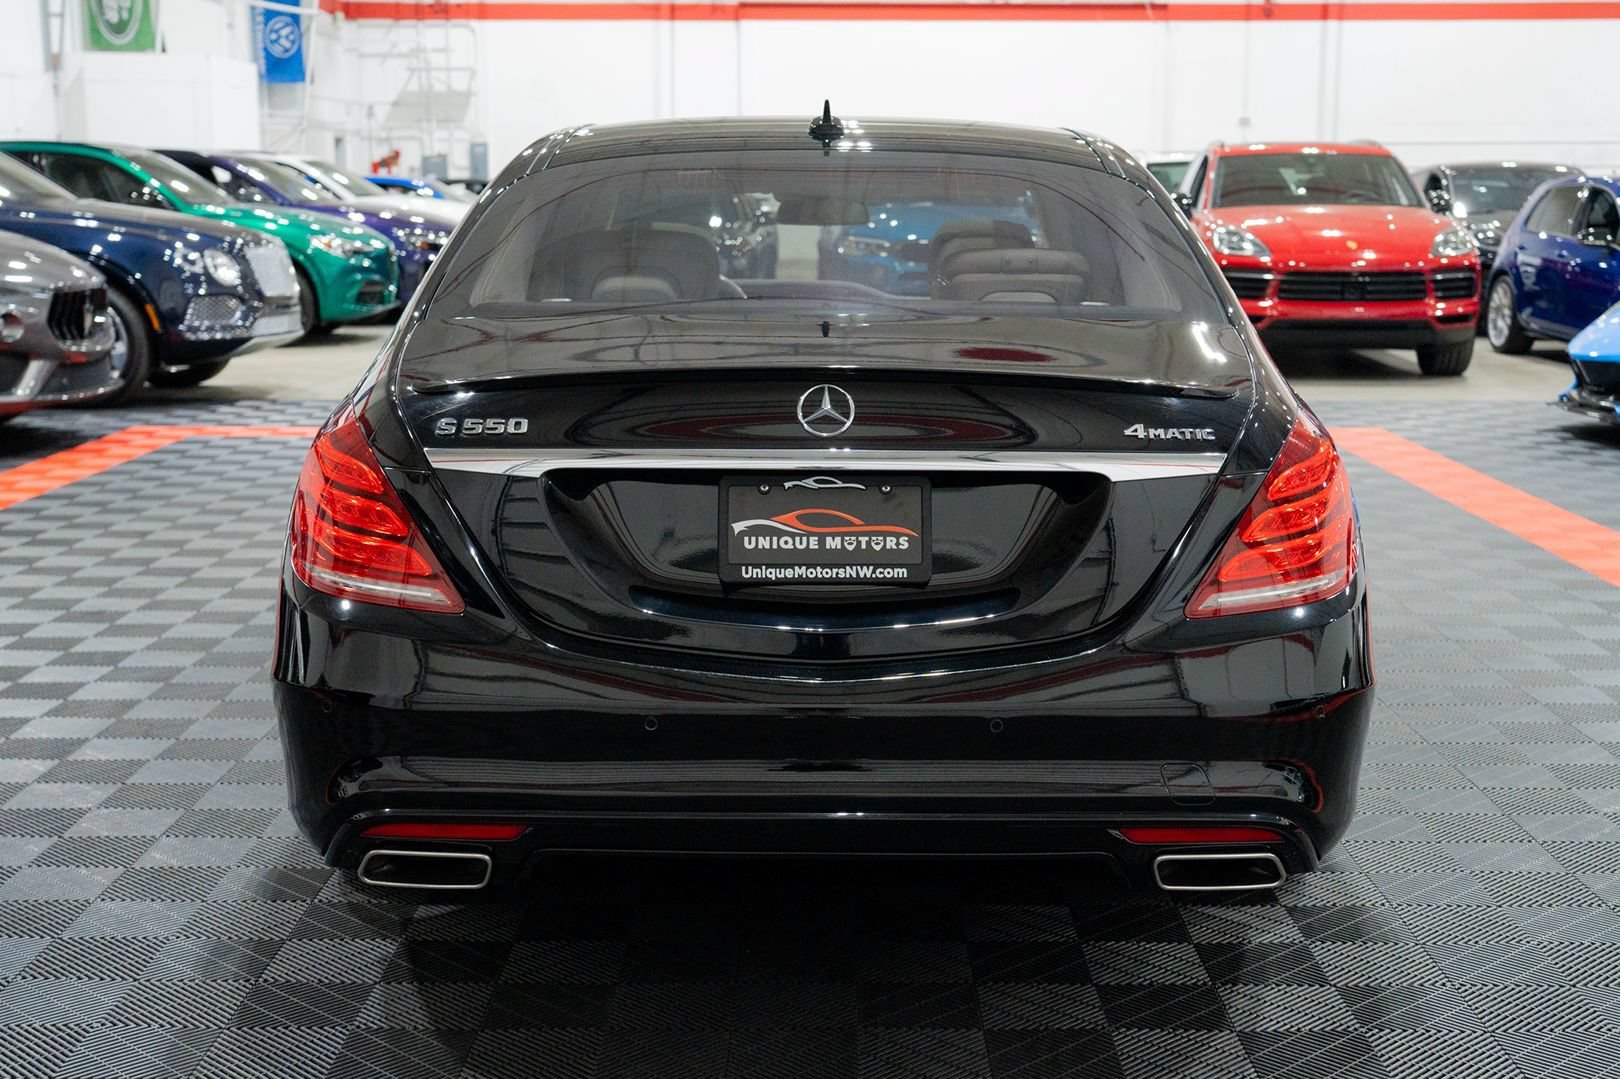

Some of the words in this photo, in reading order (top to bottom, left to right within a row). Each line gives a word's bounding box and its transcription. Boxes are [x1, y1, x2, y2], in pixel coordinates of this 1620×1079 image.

[435, 418, 457, 435] S
[462, 418, 529, 434] 550
[1123, 423, 1216, 440] 4MATIC
[743, 536, 819, 550] UNIQUE
[825, 536, 910, 551] MOTORS
[741, 565, 908, 580] UniqueMotorsNW.com
